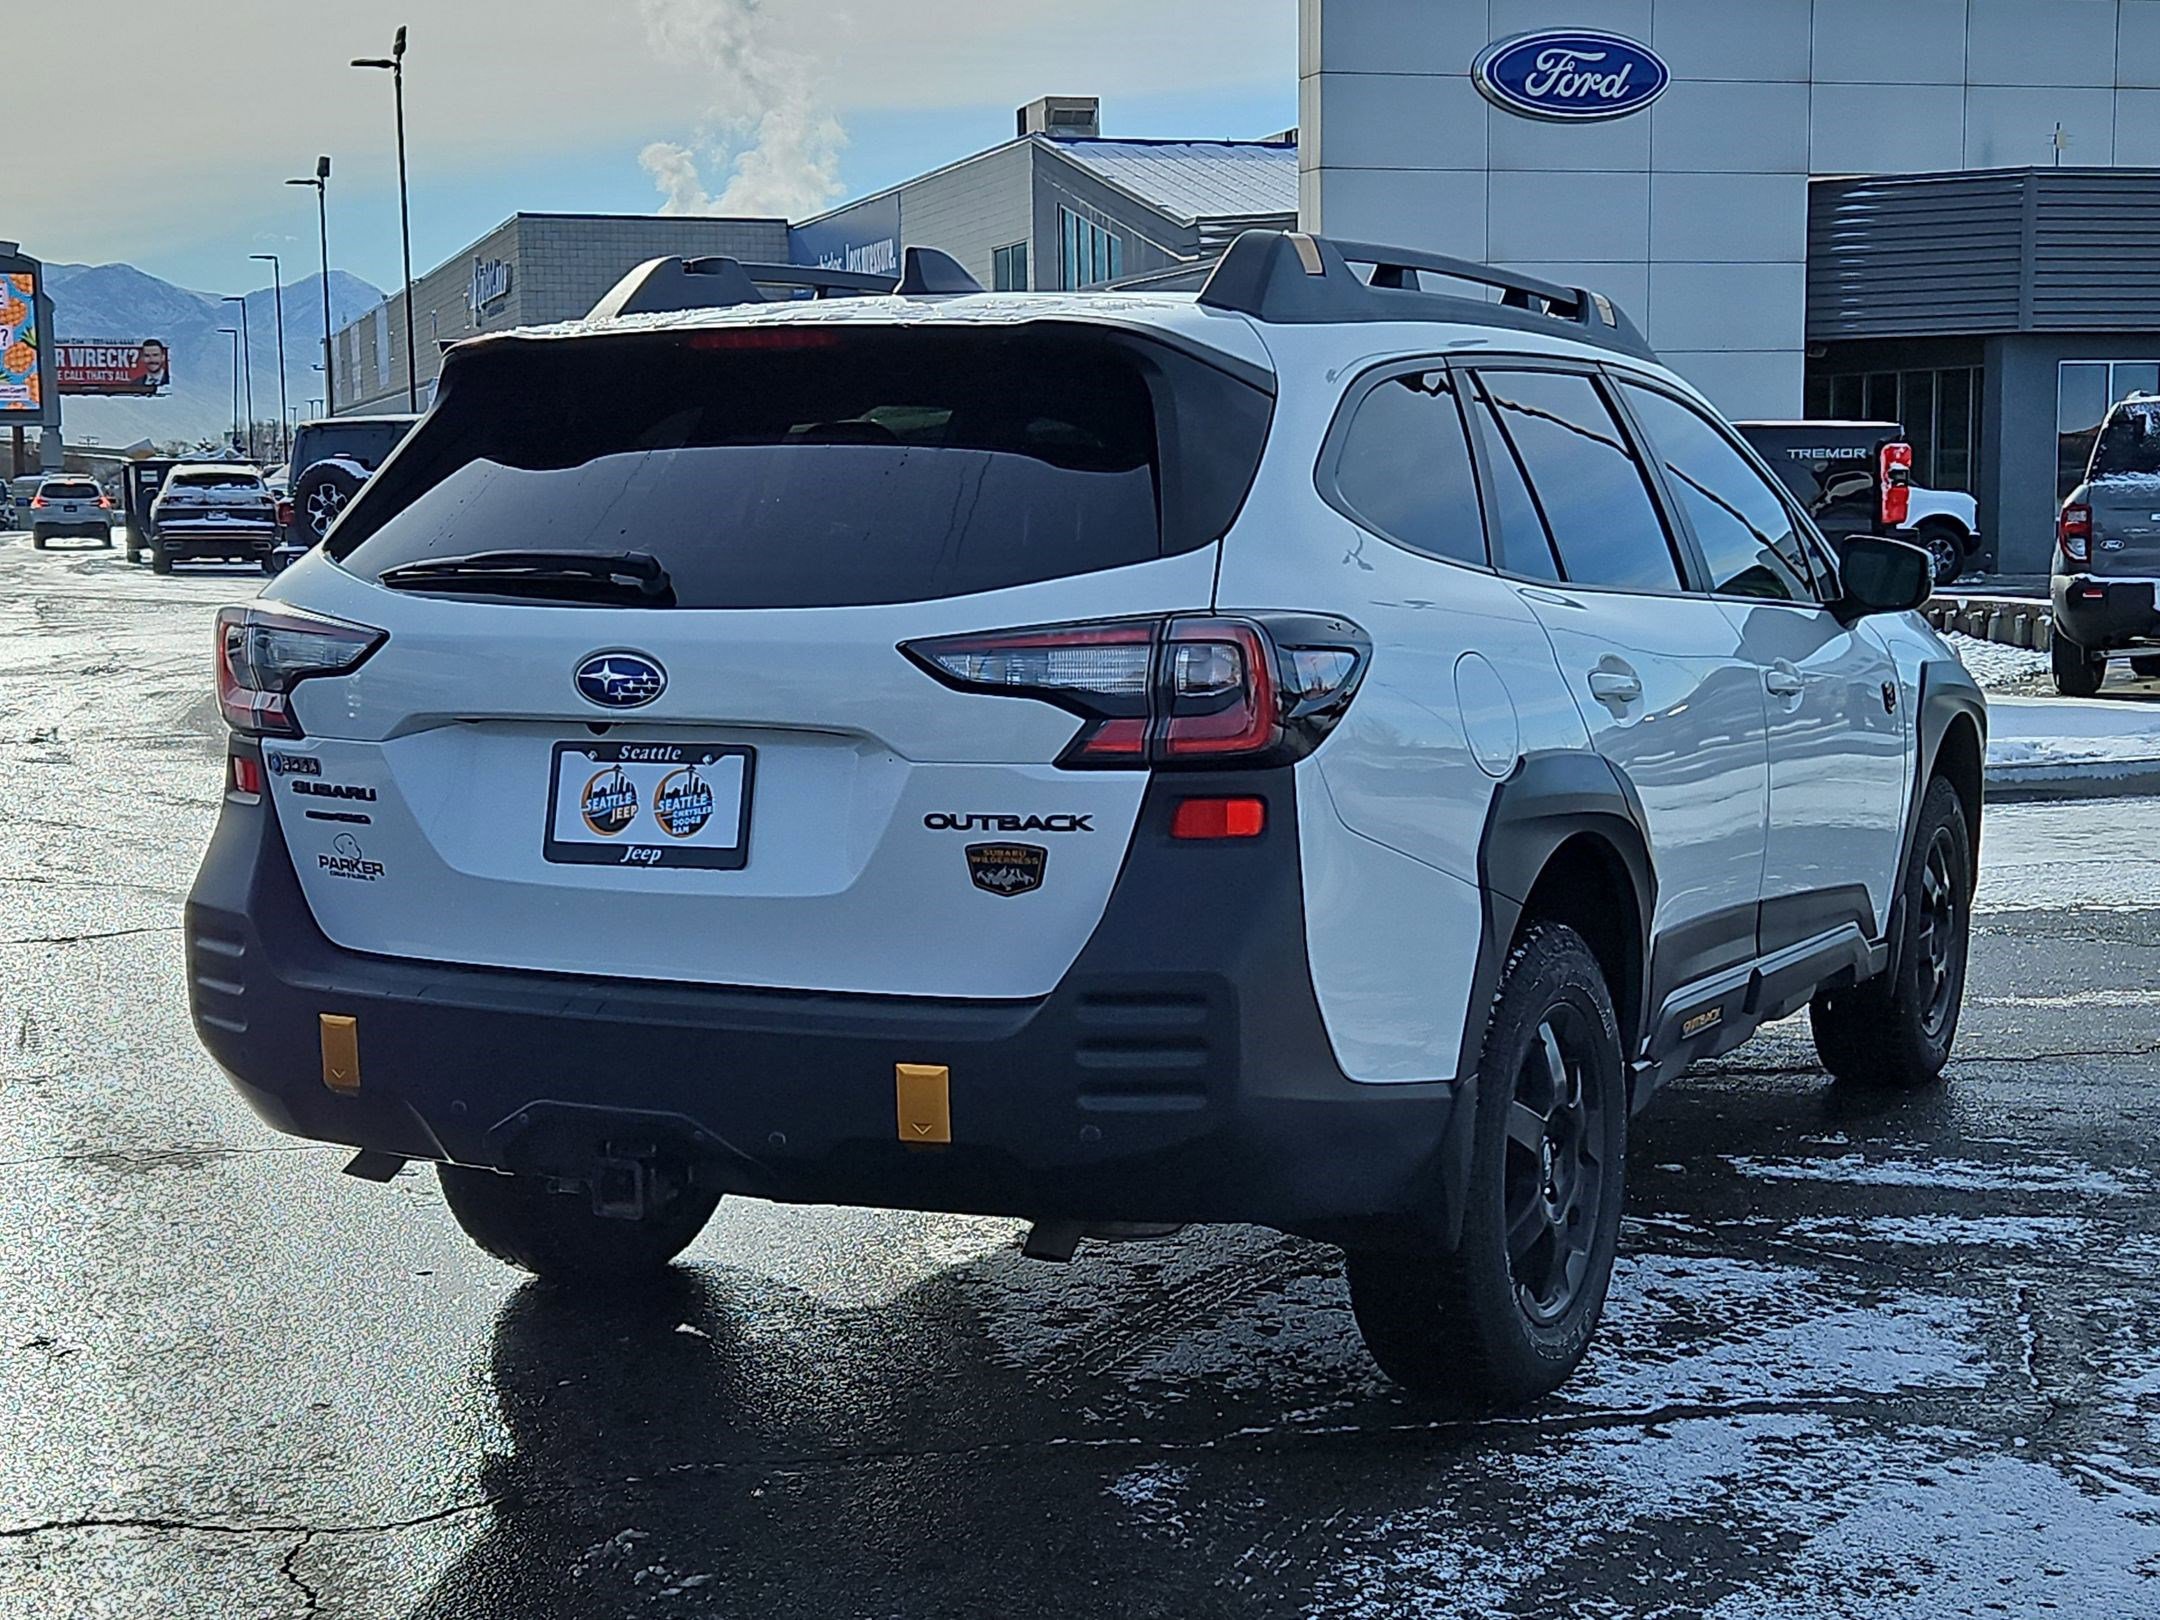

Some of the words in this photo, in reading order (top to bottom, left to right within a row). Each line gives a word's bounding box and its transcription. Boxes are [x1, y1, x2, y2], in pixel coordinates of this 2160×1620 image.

[1525, 48, 1632, 99] Ford
[69, 347, 139, 368] WRECK?
[64, 370, 85, 380] CALL
[86, 370, 114, 380] THAT'S
[115, 371, 130, 381] ALL
[1786, 448, 1867, 459] TREMOR
[618, 745, 682, 760] Seattle
[291, 780, 377, 801] SUBARU
[586, 792, 632, 811] SEATTLE
[658, 793, 708, 812] SEATTLE
[609, 805, 638, 824] JEEP
[672, 805, 712, 818] CHRYSLER
[672, 815, 701, 826] DODGE
[672, 826, 690, 834] RAM
[923, 813, 1095, 832] OUTBACK
[620, 846, 662, 864] Jeep
[971, 856, 1039, 865] WILDERNESS
[983, 849, 1027, 857] SUBARU
[318, 854, 385, 877] PARKER
